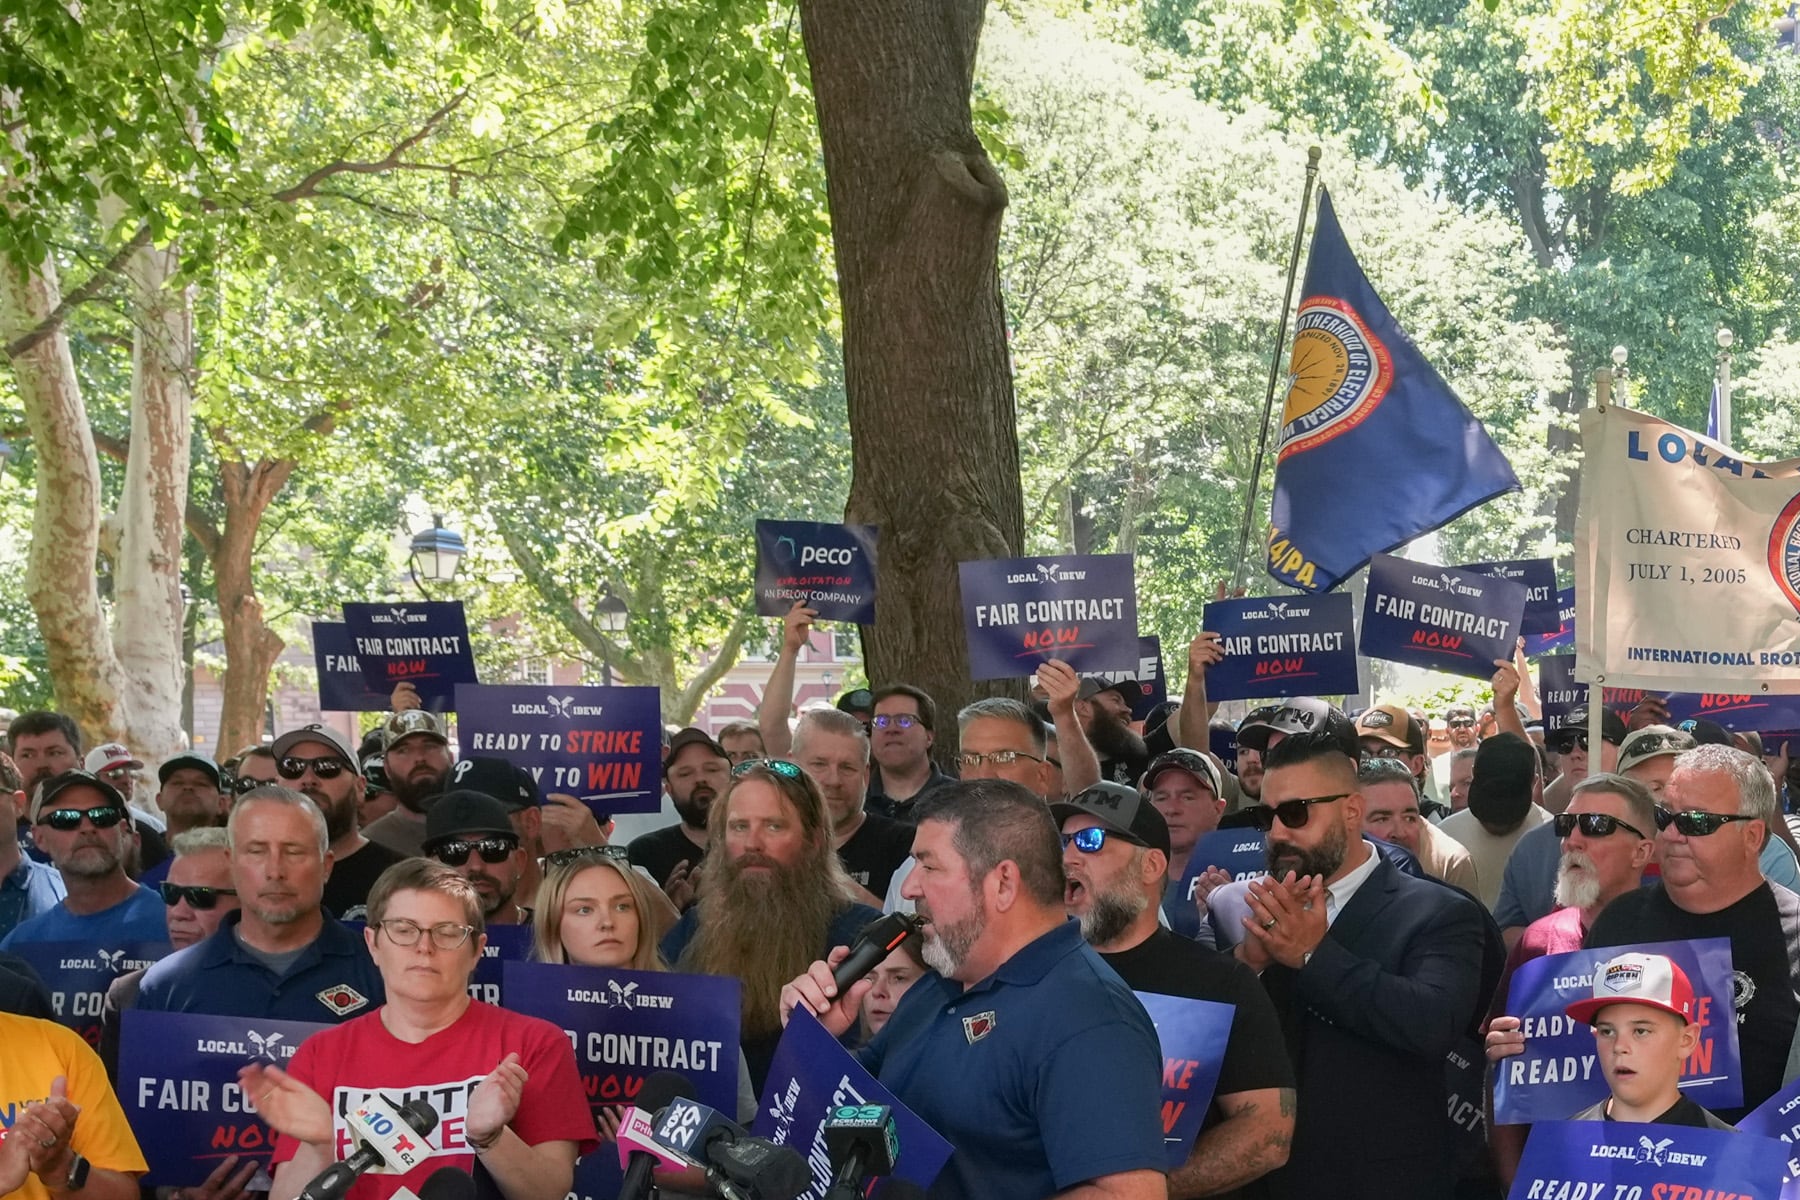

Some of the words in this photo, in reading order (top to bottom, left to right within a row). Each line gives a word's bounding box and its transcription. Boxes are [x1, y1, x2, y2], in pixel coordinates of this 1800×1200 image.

[1349, 353, 1368, 367] OF
[1626, 528, 1741, 551] CHARTERED
[801, 545, 852, 567] peco
[1007, 573, 1038, 583] LOCAL
[1059, 571, 1086, 581] IBEW
[1627, 563, 1672, 582] JULY
[1680, 566, 1695, 585] 1,
[1702, 568, 1747, 584] 2005
[764, 589, 775, 599] AN
[811, 590, 861, 604] COMPANY
[1412, 575, 1440, 588] LOCAL
[1457, 586, 1483, 598] IBEW
[371, 615, 393, 623] LOCAL
[976, 603, 1019, 627] FAIR
[1025, 598, 1123, 623] CONTRACT
[1242, 610, 1269, 620] LOCAL
[1287, 608, 1310, 618] IBEW
[1375, 594, 1415, 621] FAIR
[1420, 603, 1510, 641] CONTRACT
[356, 637, 383, 656] FAIR
[386, 636, 460, 656] CONTRACT
[1023, 626, 1079, 648] NOW
[1257, 632, 1343, 654] CONTRACT
[1412, 629, 1463, 649] NOW
[387, 659, 427, 674] NOW
[1256, 657, 1303, 675] NOW
[1628, 647, 1755, 666] INTERNATIONAL
[1548, 690, 1578, 703] READY
[512, 704, 548, 715] LOCAL
[573, 706, 603, 715] IBEW
[473, 732, 531, 750] READY
[540, 734, 561, 750] TO
[566, 730, 643, 754] STRIKE
[454, 760, 474, 783] P
[555, 767, 580, 787] TO
[587, 762, 642, 790] WIN
[1232, 841, 1261, 853] LOCAL
[60, 958, 97, 970] LOCAL
[567, 989, 608, 1005] LOCAL
[636, 994, 673, 1009] IBEW
[198, 1039, 247, 1056] LOCAL
[588, 1032, 722, 1073] CONTRACT
[1510, 1055, 1597, 1086] READY
[138, 1077, 209, 1113] FAIR
[783, 1077, 801, 1112] IBEW
[369, 1111, 394, 1136] 10
[660, 1103, 688, 1138] FOX
[857, 1106, 883, 1119] 3
[670, 1105, 701, 1148] 29
[400, 1152, 415, 1166] 62
[1590, 1144, 1636, 1160] LOCAL
[1667, 1152, 1707, 1168] IBEW
